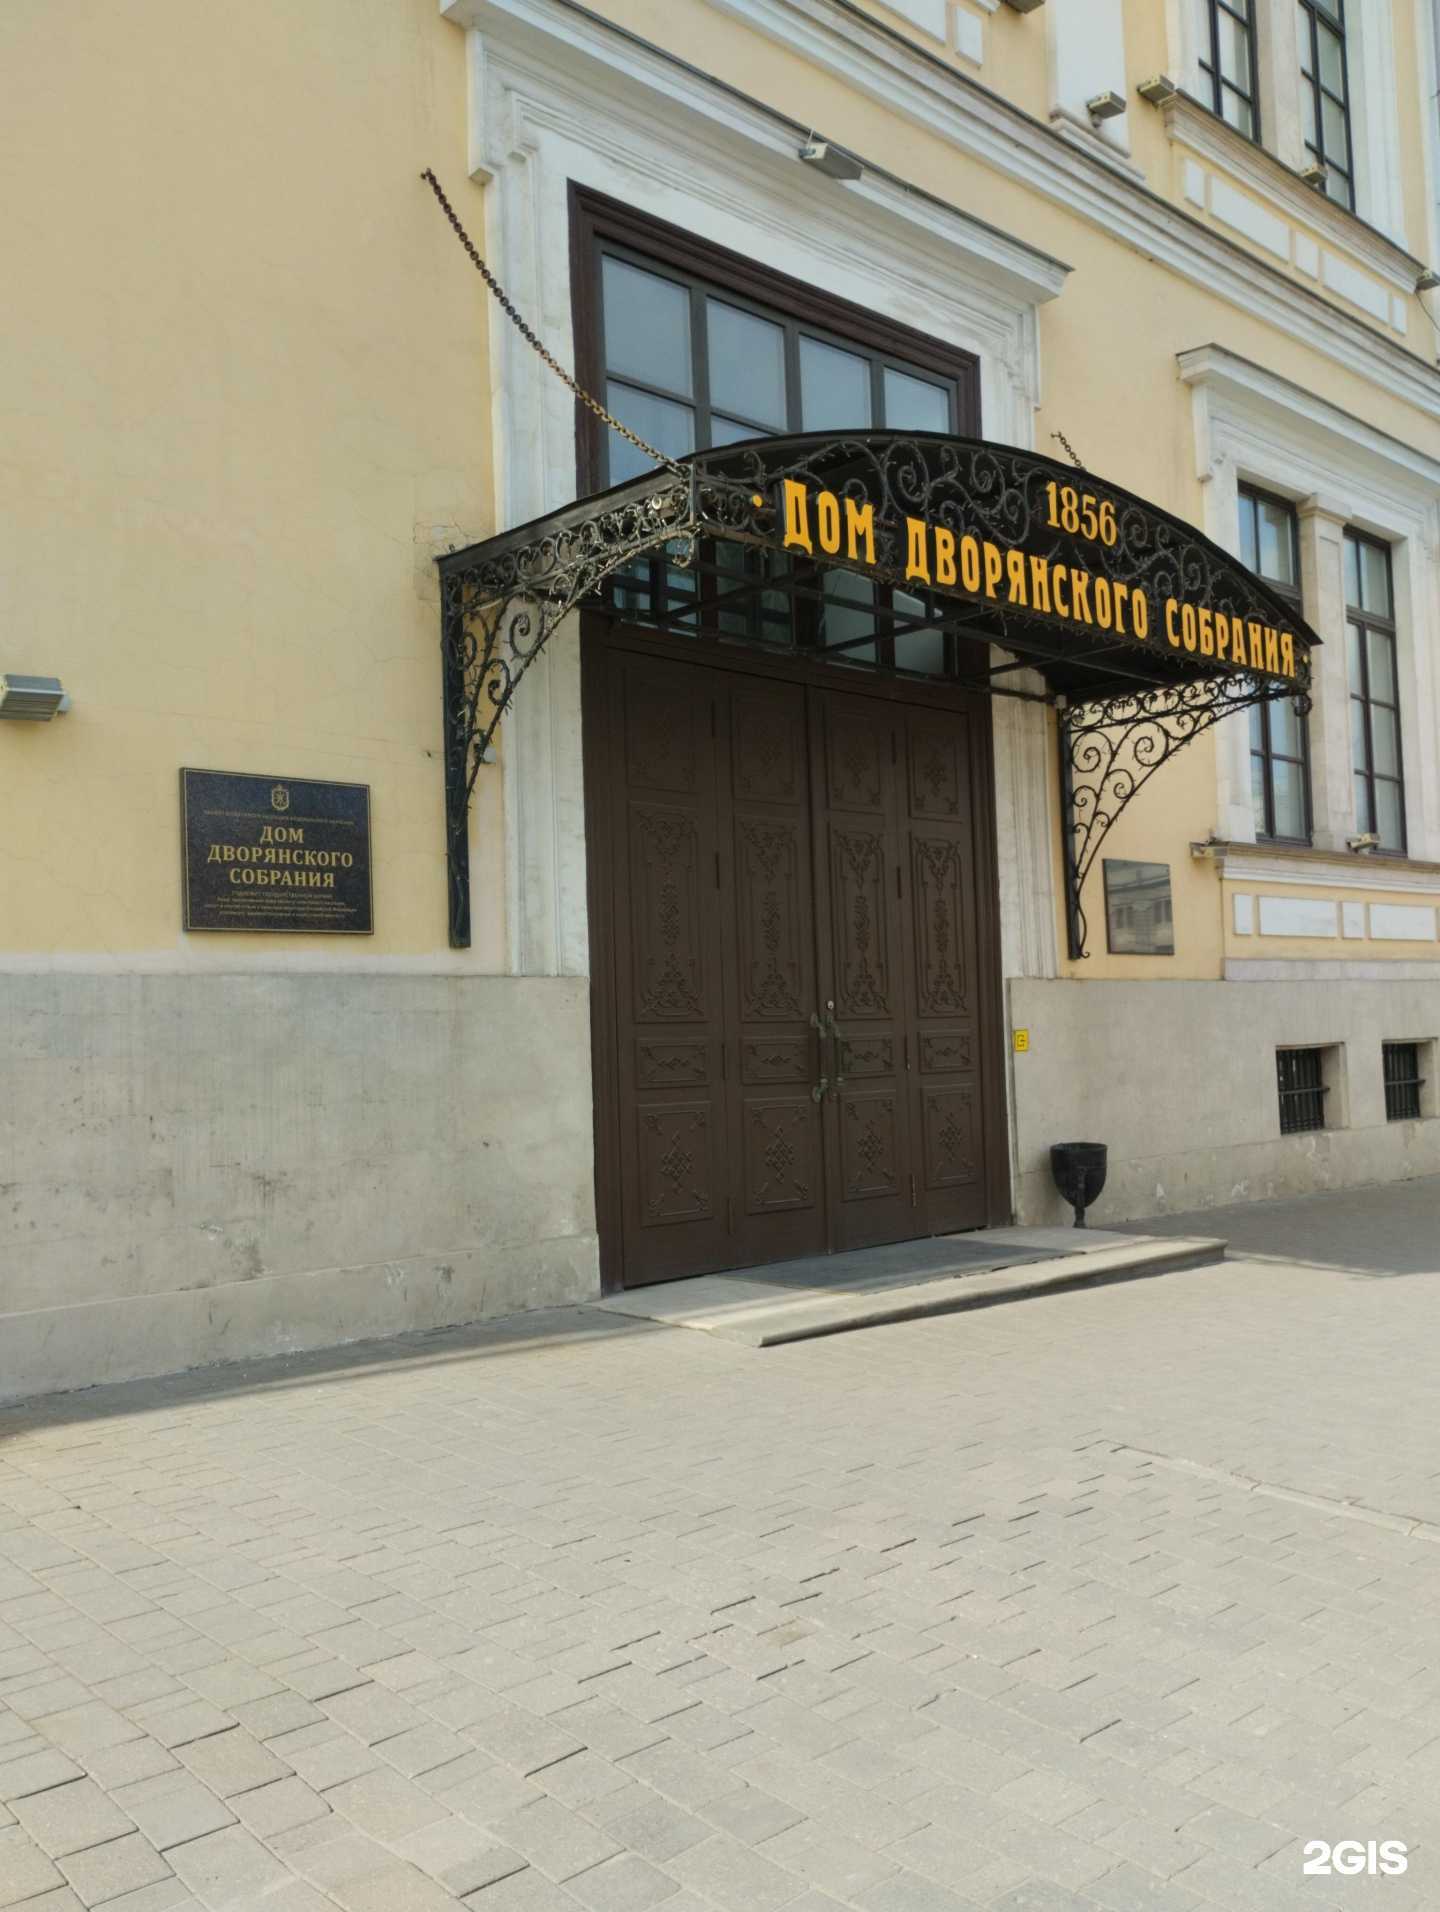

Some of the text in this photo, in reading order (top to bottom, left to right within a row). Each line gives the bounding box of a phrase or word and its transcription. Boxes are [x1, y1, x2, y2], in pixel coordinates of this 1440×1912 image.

[1045, 480, 1118, 547] 1856
[783, 479, 1296, 679] ДОМ ДВОРЯНСКОГО СОБРАНИЯ
[260, 825, 304, 844] ДОМ
[208, 845, 353, 867] ДВОРЯНСКОГО
[230, 868, 334, 887] СОБРАНИЯ
